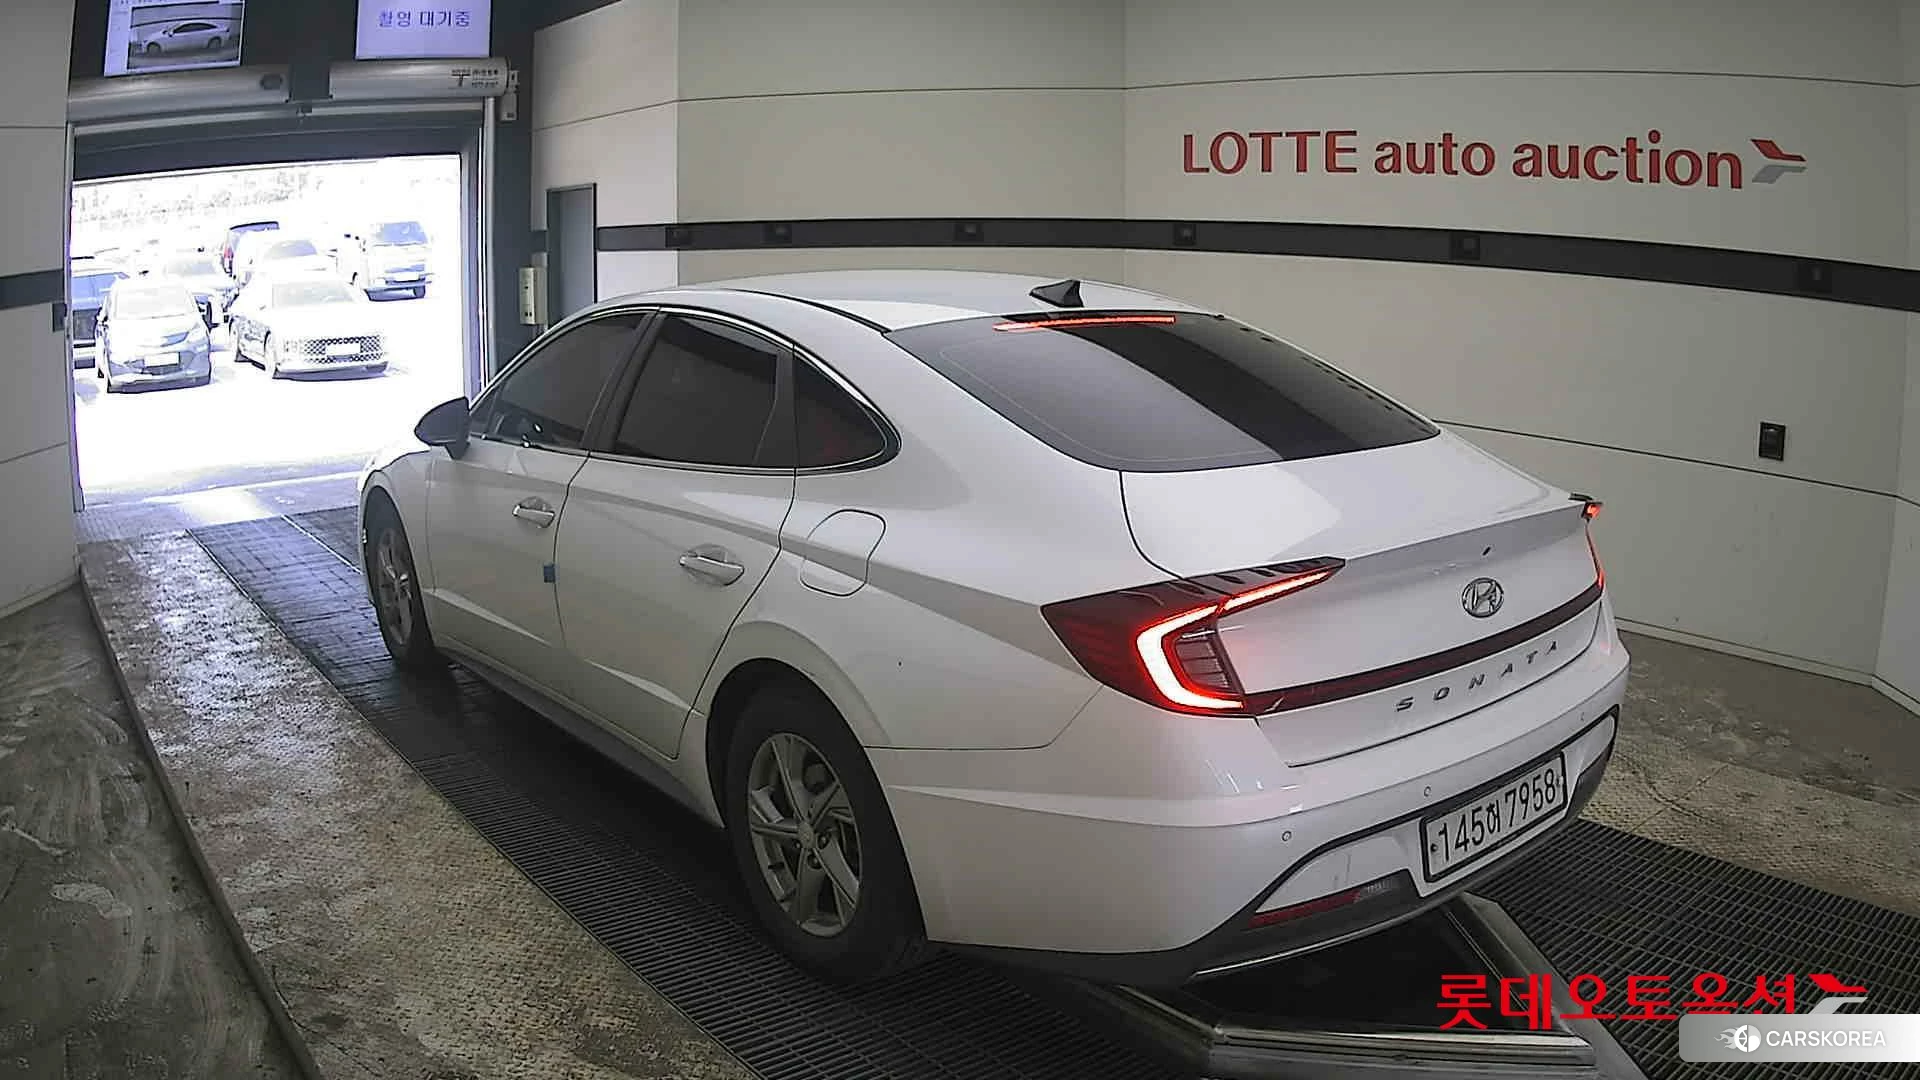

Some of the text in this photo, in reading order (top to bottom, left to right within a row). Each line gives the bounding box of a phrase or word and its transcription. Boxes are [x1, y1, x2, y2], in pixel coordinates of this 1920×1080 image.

[1183, 129, 1743, 190] LOTTE auto auction
[1396, 641, 1558, 711] SONATA
